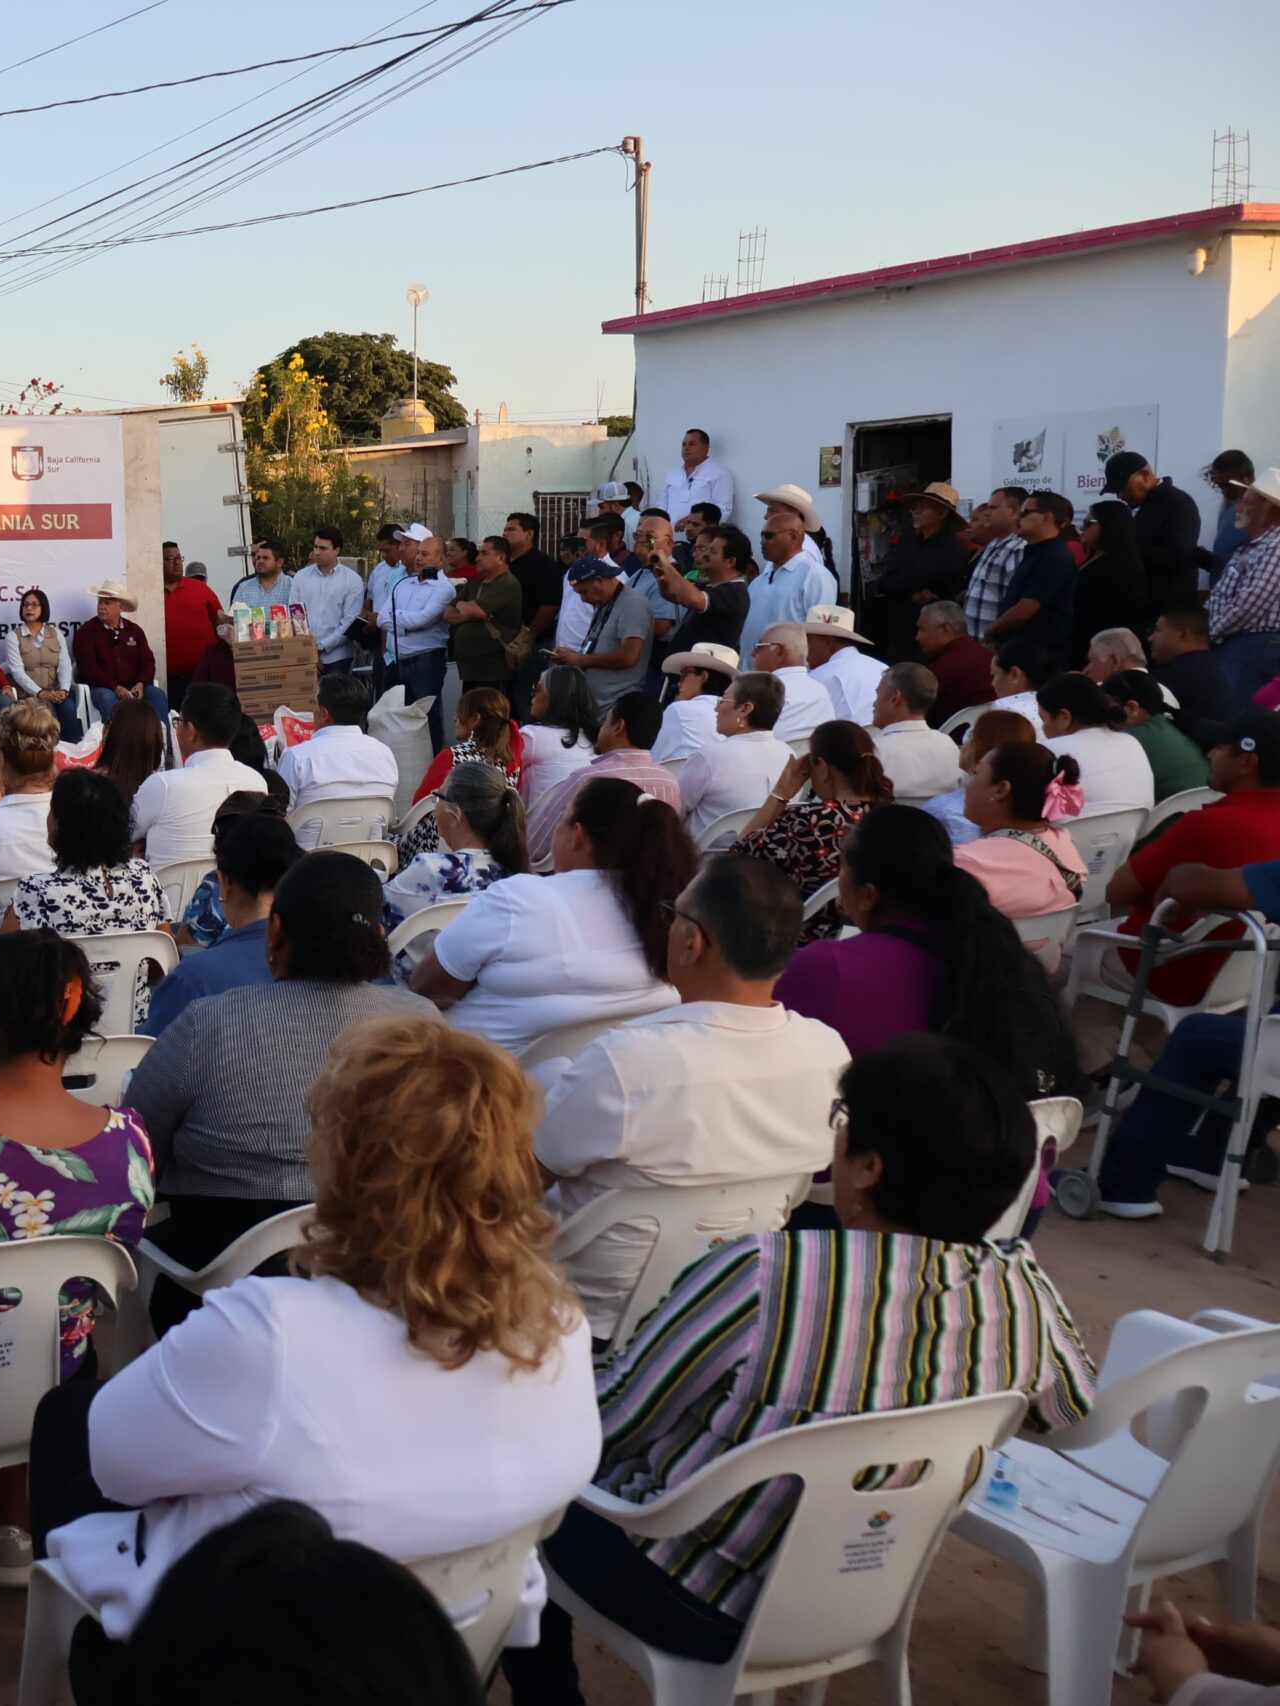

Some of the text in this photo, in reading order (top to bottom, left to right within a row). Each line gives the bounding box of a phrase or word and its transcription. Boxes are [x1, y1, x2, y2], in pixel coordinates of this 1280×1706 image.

[47, 456, 63, 465] Baja
[1003, 475, 1052, 487] Gobierno de
[41, 513, 80, 530] SUR
